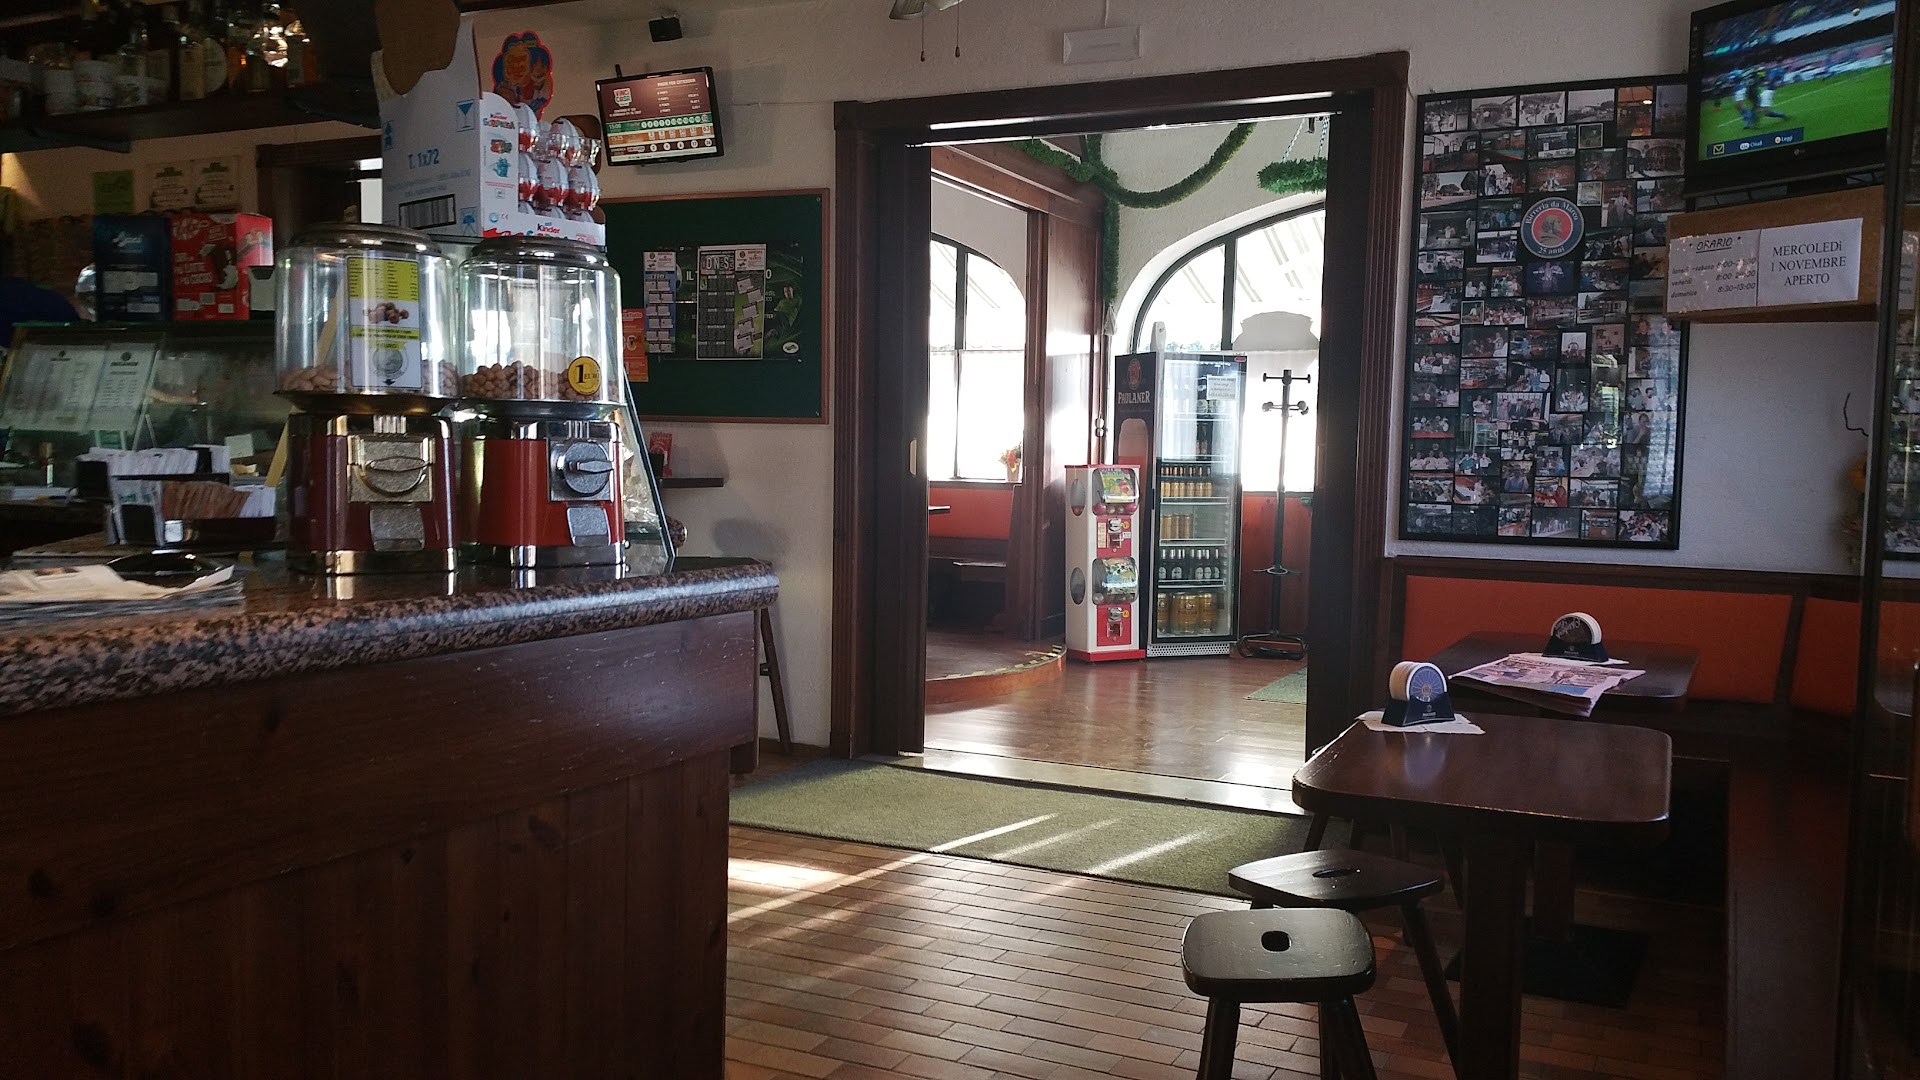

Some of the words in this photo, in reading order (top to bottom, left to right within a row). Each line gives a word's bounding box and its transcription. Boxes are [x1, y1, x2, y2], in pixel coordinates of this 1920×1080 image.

[418, 148, 440, 168] 1x72
[1525, 201, 1549, 224] Birreria
[1550, 200, 1560, 208] da
[1562, 201, 1579, 221] Marco
[537, 223, 561, 234] kinder
[1548, 245, 1565, 255] anni
[1696, 237, 1733, 252] ORARIO
[1771, 262, 1775, 272] 1
[1778, 256, 1847, 272] NOVEMBRE
[686, 270, 694, 281] IL
[1783, 272, 1830, 287] APERTO
[575, 364, 586, 384] 1
[1117, 390, 1151, 404] PAULANER
